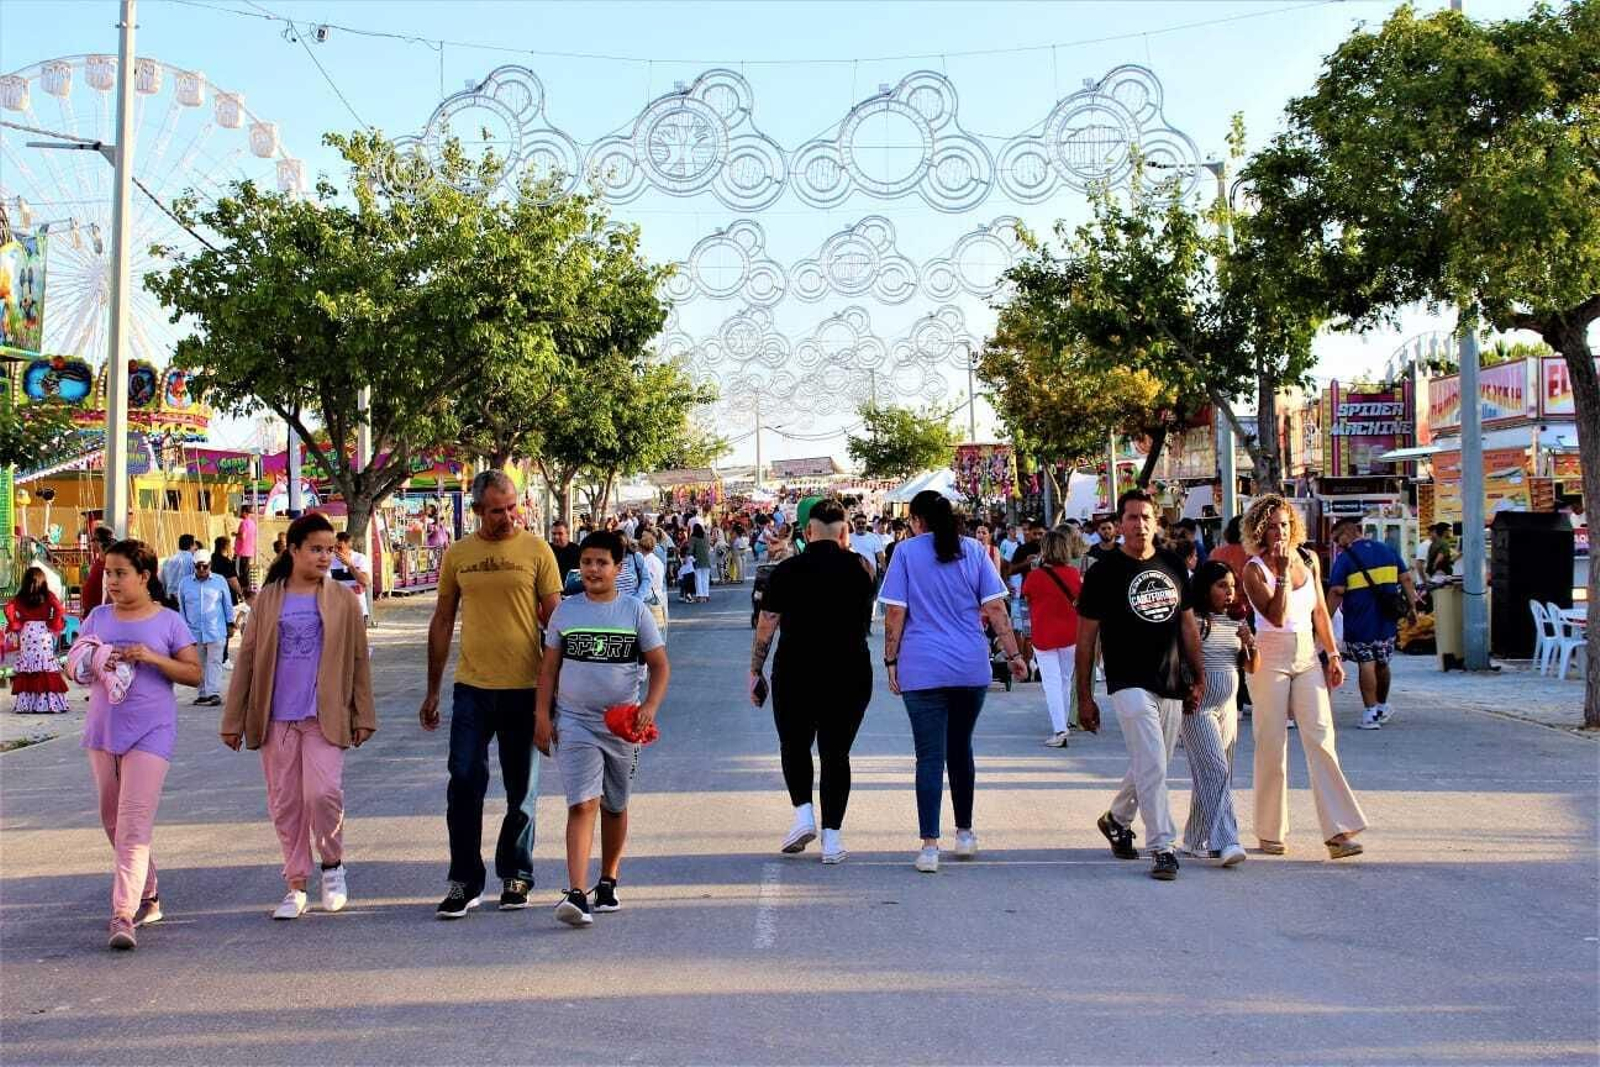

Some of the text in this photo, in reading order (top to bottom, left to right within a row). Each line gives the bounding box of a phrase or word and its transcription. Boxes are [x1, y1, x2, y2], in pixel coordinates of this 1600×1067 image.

[1337, 402, 1404, 417] SPIDER
[1329, 420, 1412, 436] MACHINE
[566, 634, 636, 658] SPORT
